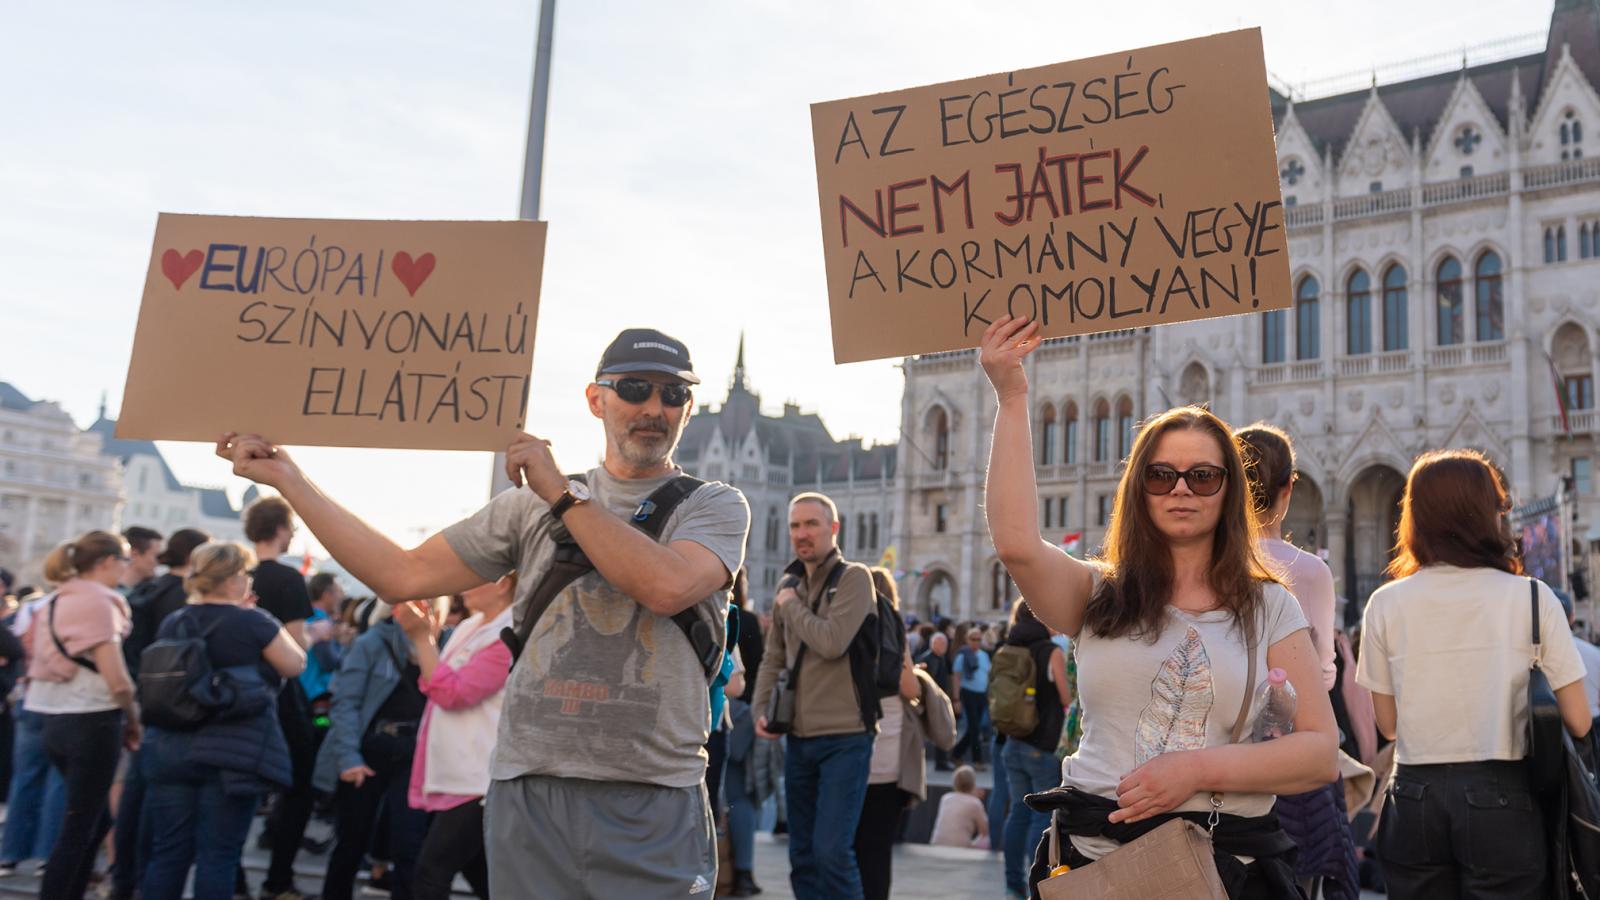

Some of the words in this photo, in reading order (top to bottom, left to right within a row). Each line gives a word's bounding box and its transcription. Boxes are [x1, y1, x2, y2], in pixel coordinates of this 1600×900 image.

[835, 105, 915, 164] AZ
[939, 55, 1187, 148] EGÉSZSÉG
[840, 170, 974, 248] NEM
[199, 234, 385, 298] EURÓPAI
[848, 250, 887, 299] A
[897, 216, 1138, 294] KORMÁNY
[1154, 200, 1283, 259] VEGYE
[236, 296, 529, 355] SZÍNVONALÚ
[963, 259, 1260, 337] KOMOLYAN!
[302, 360, 530, 430] ELLÁTÁST!
